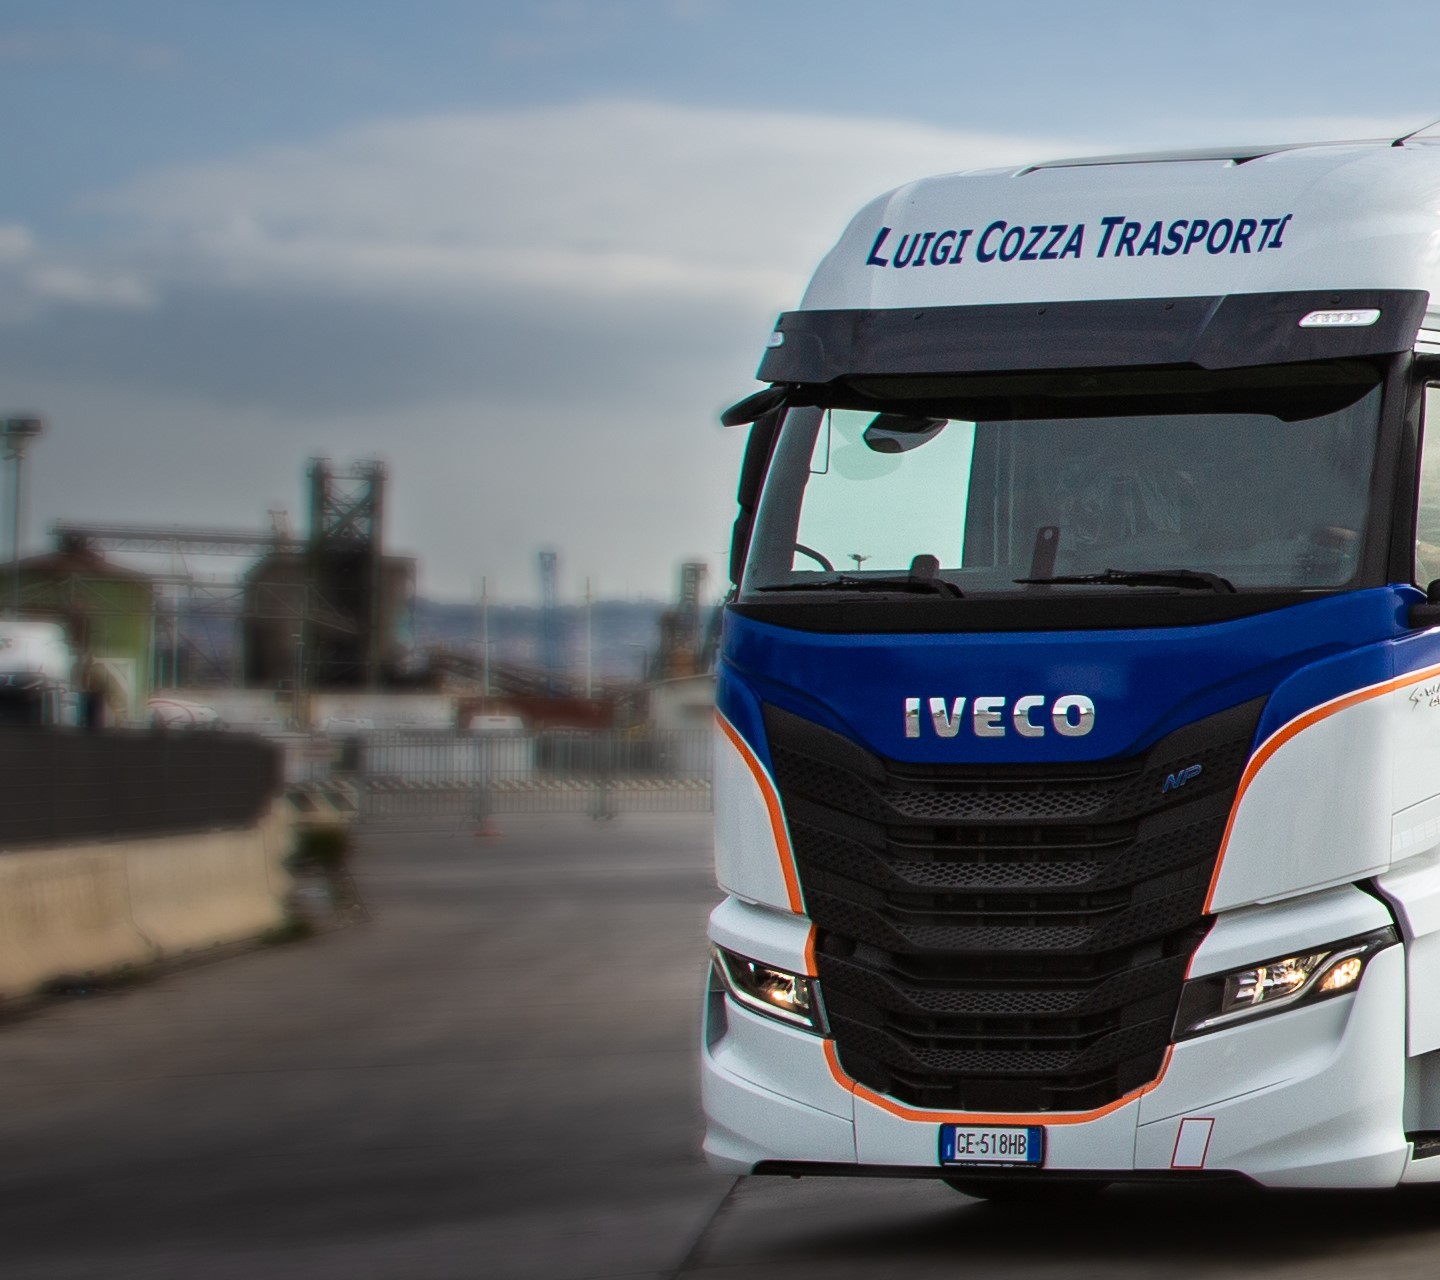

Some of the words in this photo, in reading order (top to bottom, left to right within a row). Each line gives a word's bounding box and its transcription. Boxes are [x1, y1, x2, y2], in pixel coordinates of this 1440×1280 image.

[866, 226, 974, 269] LUIGI
[976, 220, 1086, 264] COZZA
[1096, 213, 1294, 259] TRASPORTI
[904, 694, 1095, 738] IVECO
[1161, 764, 1202, 794] NP
